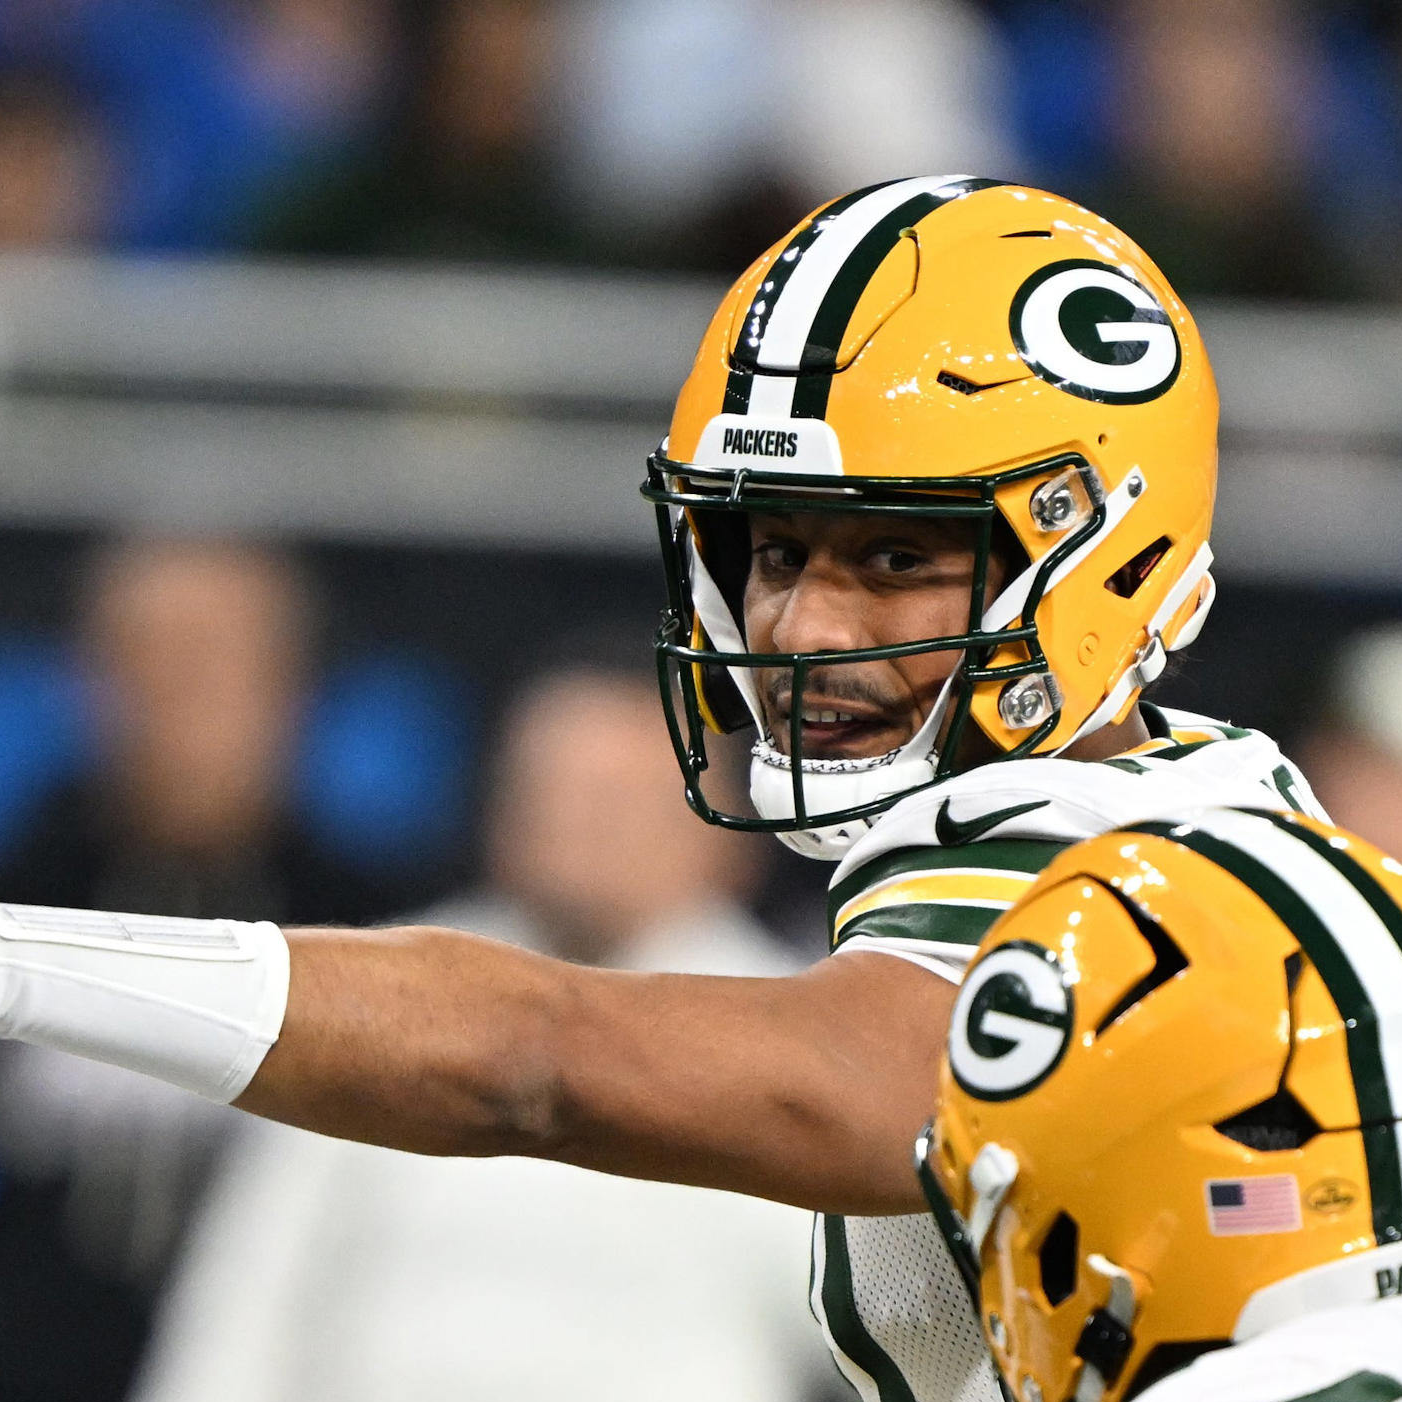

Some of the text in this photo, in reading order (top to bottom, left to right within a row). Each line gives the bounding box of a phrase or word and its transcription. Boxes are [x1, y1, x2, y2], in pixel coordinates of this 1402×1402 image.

[1017, 264, 1179, 397] G
[723, 428, 798, 458] PACKERS
[948, 944, 1068, 1094] G
